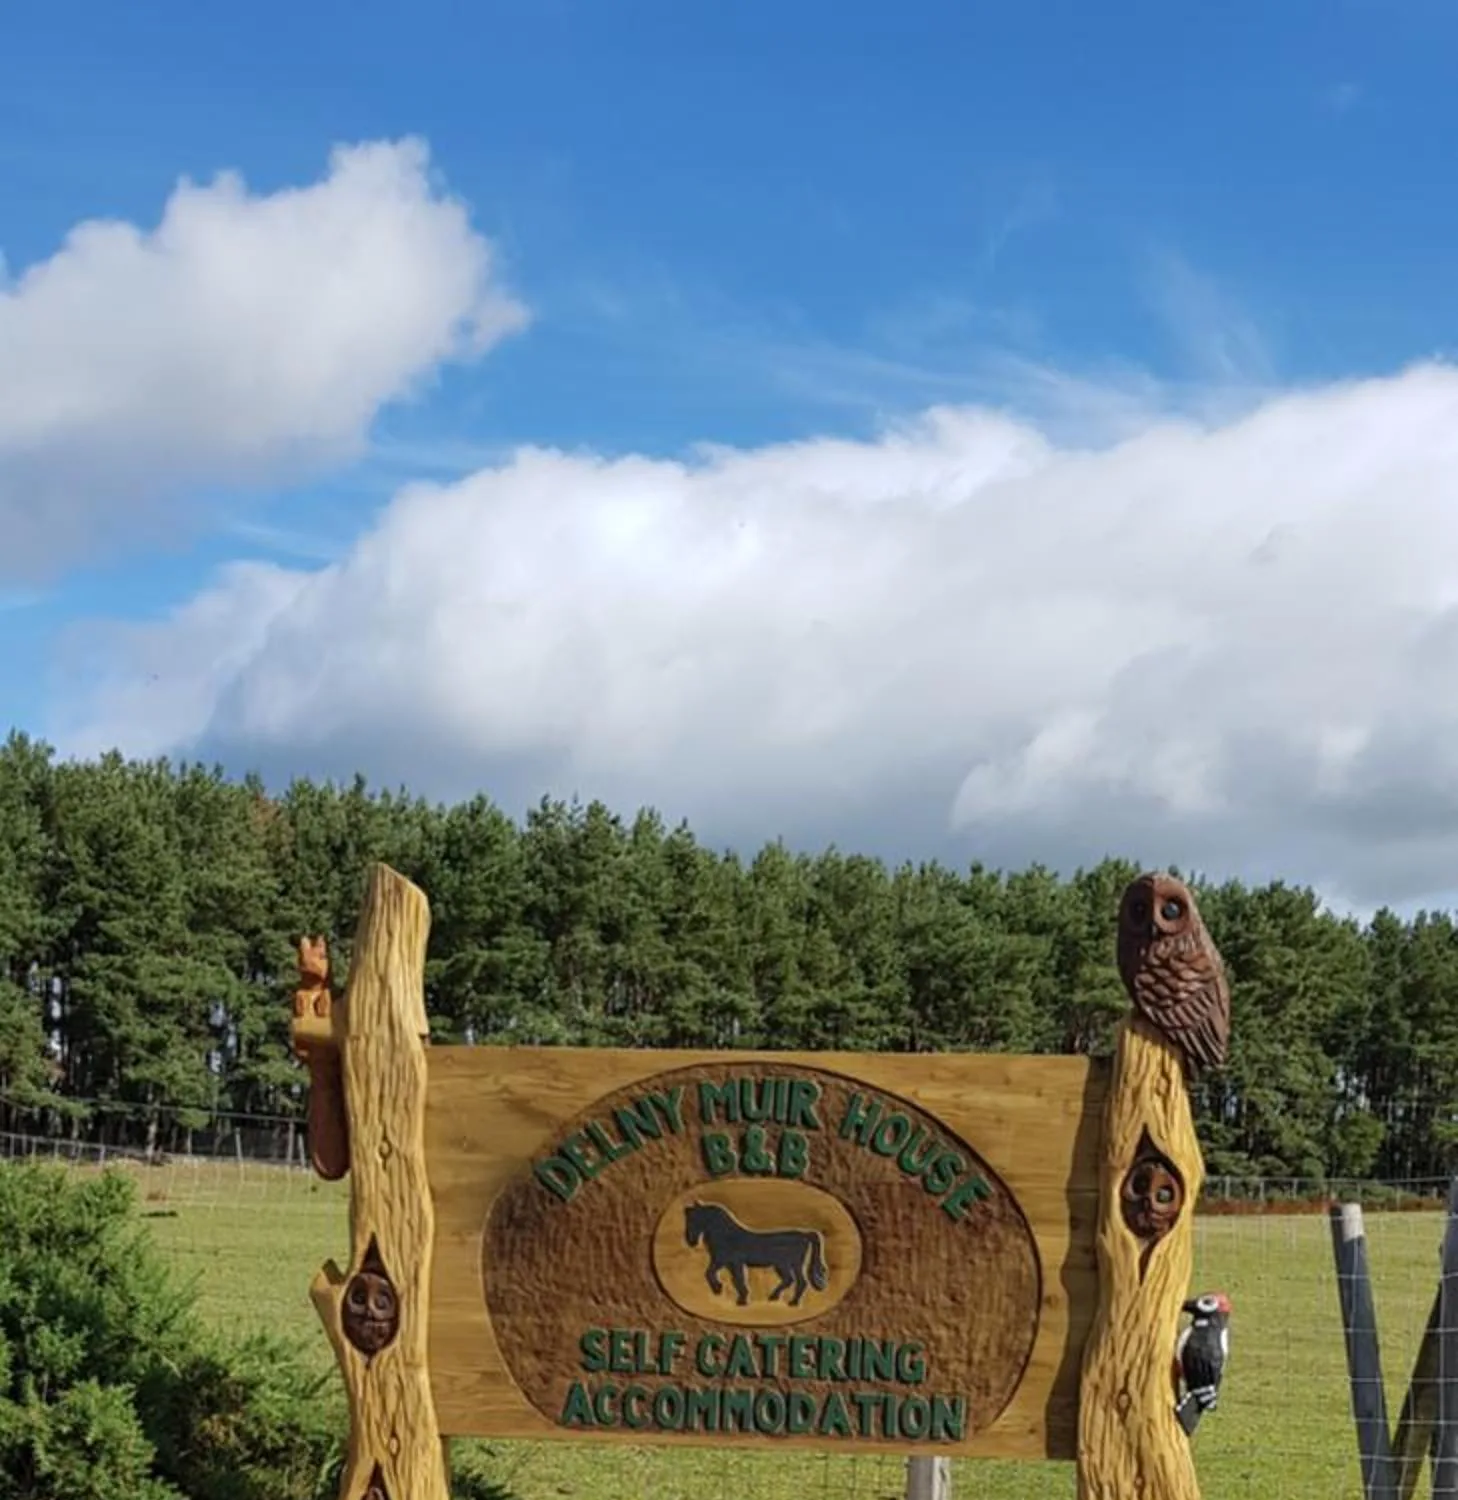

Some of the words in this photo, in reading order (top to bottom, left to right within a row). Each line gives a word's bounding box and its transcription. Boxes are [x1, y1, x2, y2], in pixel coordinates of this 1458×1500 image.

[536, 1087, 687, 1199] DELNY
[700, 1078, 822, 1128] MUIR
[841, 1094, 994, 1220] HOUSE
[704, 1126, 810, 1177] B&B
[580, 1329, 687, 1374] SELF
[696, 1333, 926, 1383] CATERING
[562, 1382, 967, 1440] ACCOMMODATION
